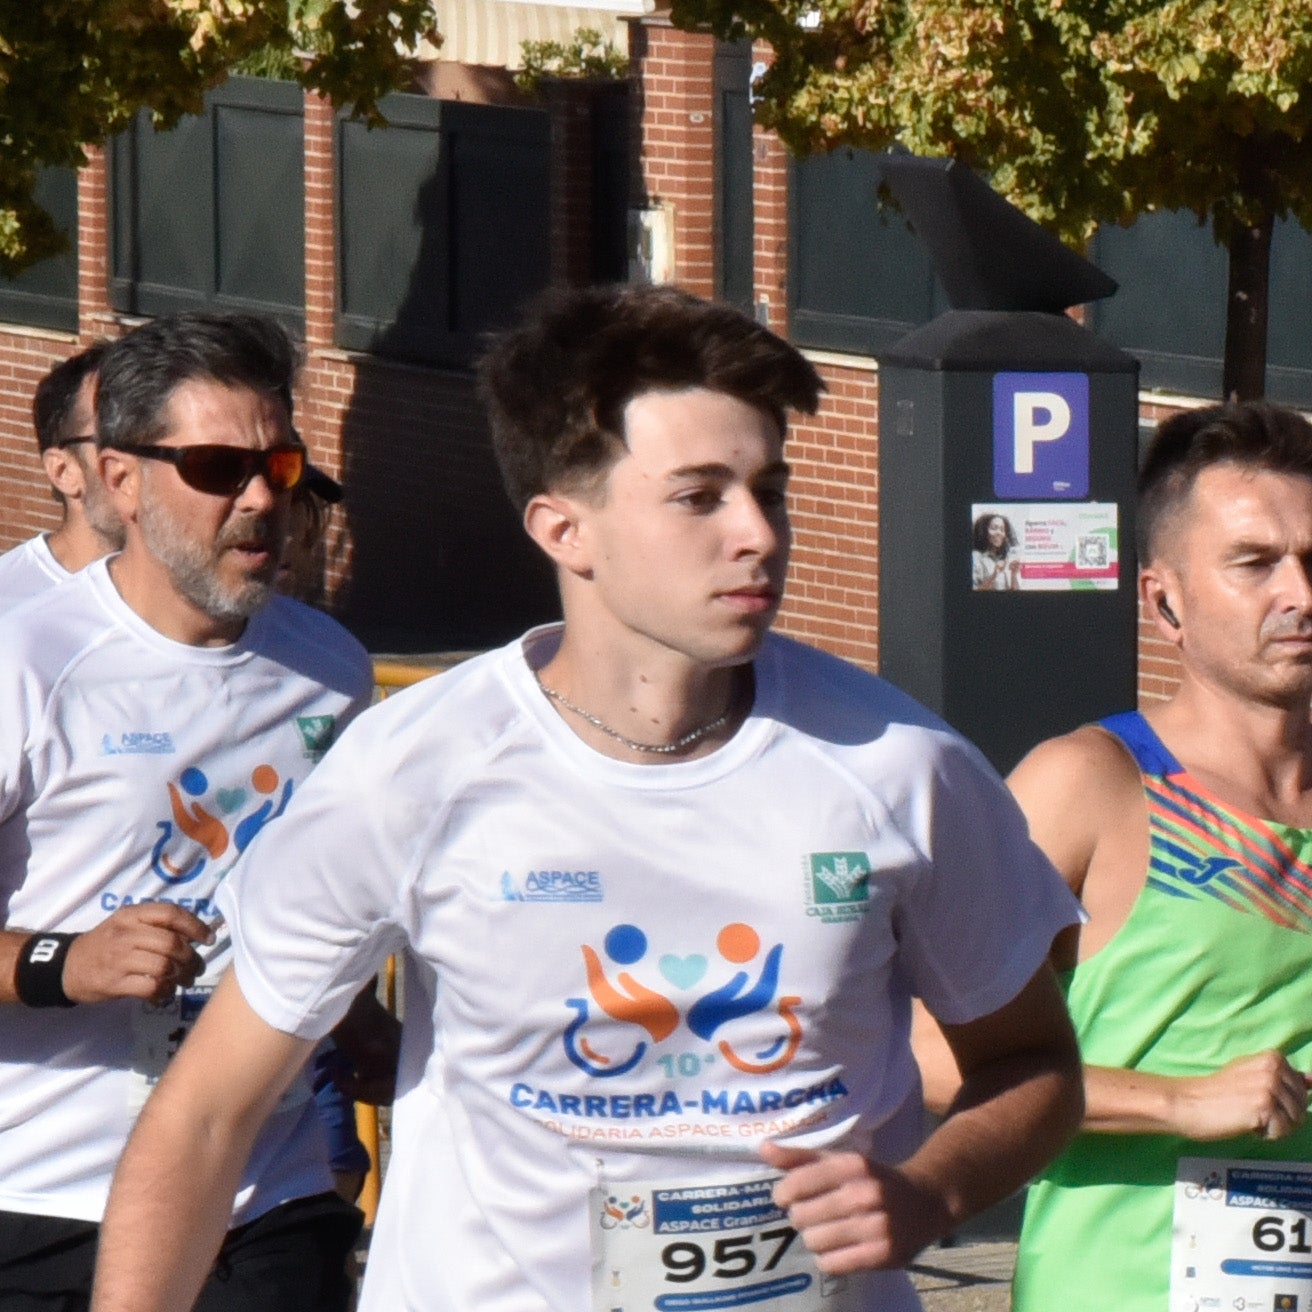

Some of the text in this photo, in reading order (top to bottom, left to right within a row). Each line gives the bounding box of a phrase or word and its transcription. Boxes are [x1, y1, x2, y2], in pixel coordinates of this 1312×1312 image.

[1012, 391, 1071, 474] P
[526, 870, 600, 891] ASPACE
[509, 1077, 848, 1119] CARRERA-MARCHA
[649, 1124, 731, 1139] ASPACE
[657, 1183, 772, 1202] CARRERA-MA
[658, 1218, 720, 1233] ASPACE
[1252, 1215, 1312, 1254] 61
[660, 1225, 799, 1284] 957
